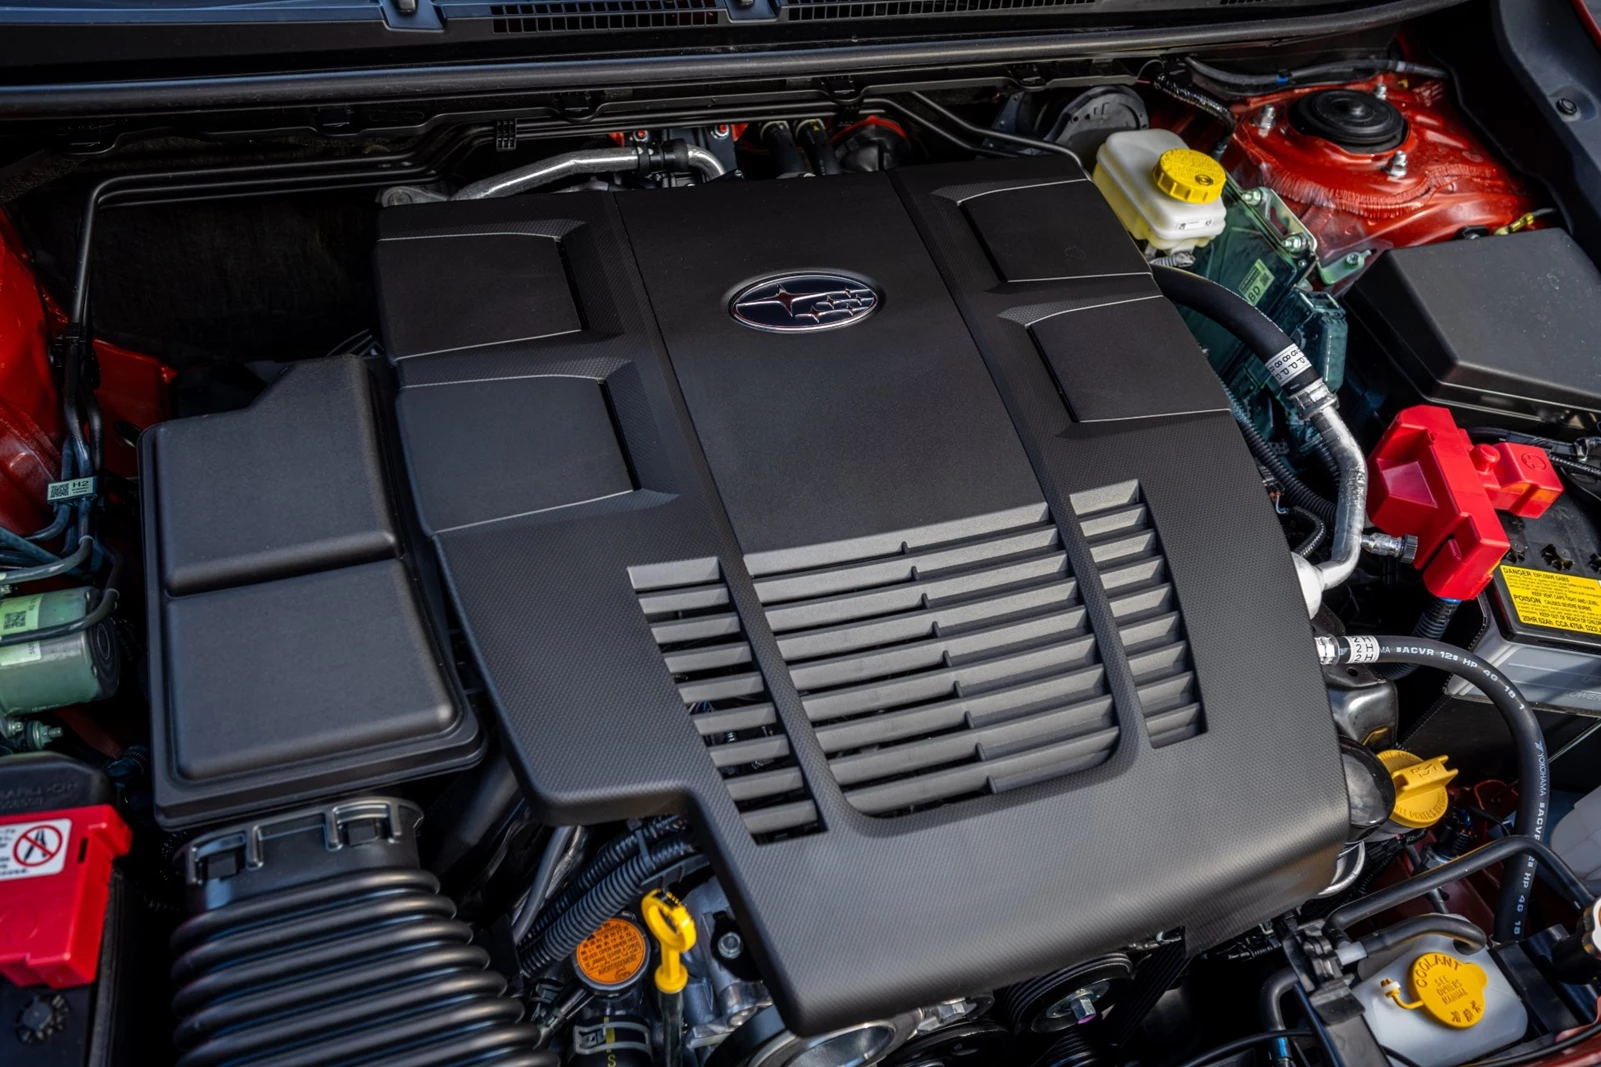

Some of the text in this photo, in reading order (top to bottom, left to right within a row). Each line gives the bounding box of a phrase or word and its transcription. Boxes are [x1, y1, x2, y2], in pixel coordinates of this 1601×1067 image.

[1248, 286, 1260, 302] BD
[73, 480, 89, 488] H2
[1502, 568, 1531, 576] DANGER
[1513, 594, 1541, 604] POISON
[1356, 644, 1373, 652] 2 H
[1463, 658, 1478, 668] HP
[1538, 752, 1547, 796] YOKOHAMA
[1523, 872, 1531, 888] HP
[1416, 954, 1462, 988] COOLANT
